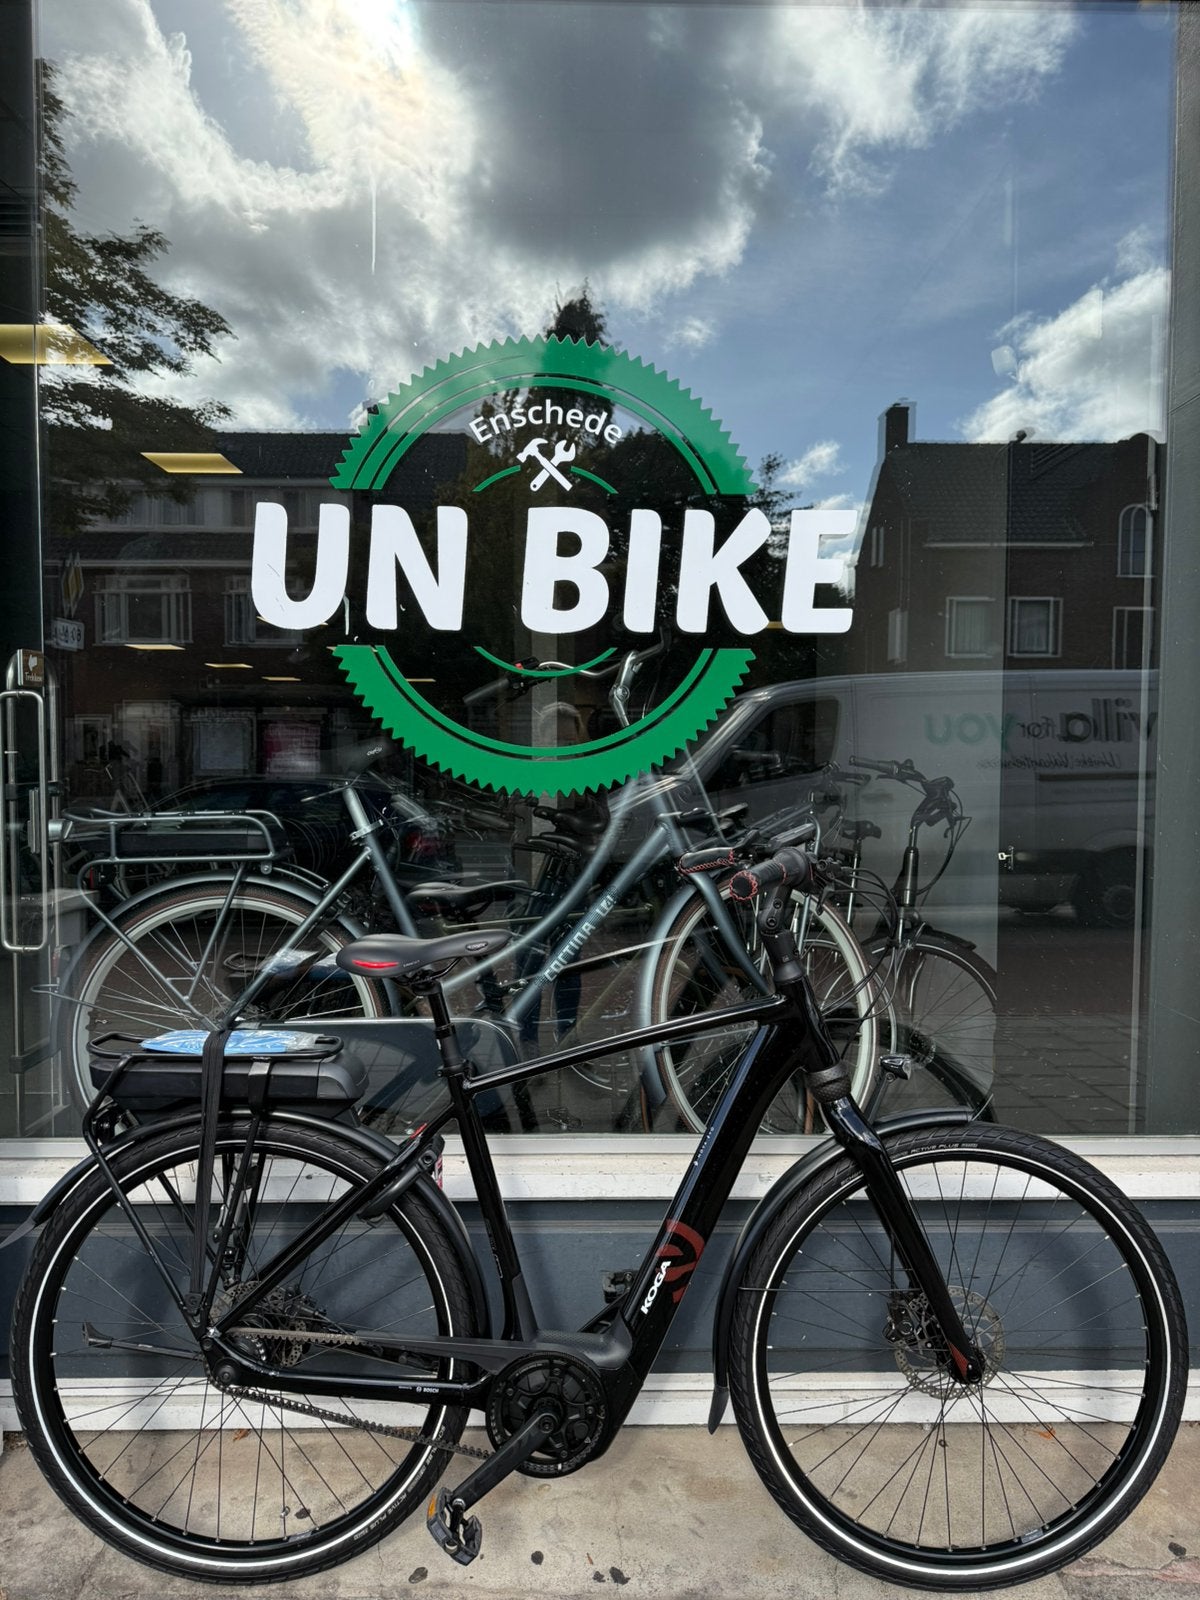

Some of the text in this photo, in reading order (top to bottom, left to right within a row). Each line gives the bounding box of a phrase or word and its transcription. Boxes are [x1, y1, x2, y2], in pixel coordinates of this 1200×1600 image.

[468, 398, 623, 444] Enschede
[250, 501, 860, 635] UN BIKE
[543, 921, 597, 982] CORTINA
[640, 1260, 672, 1315] KOGA
